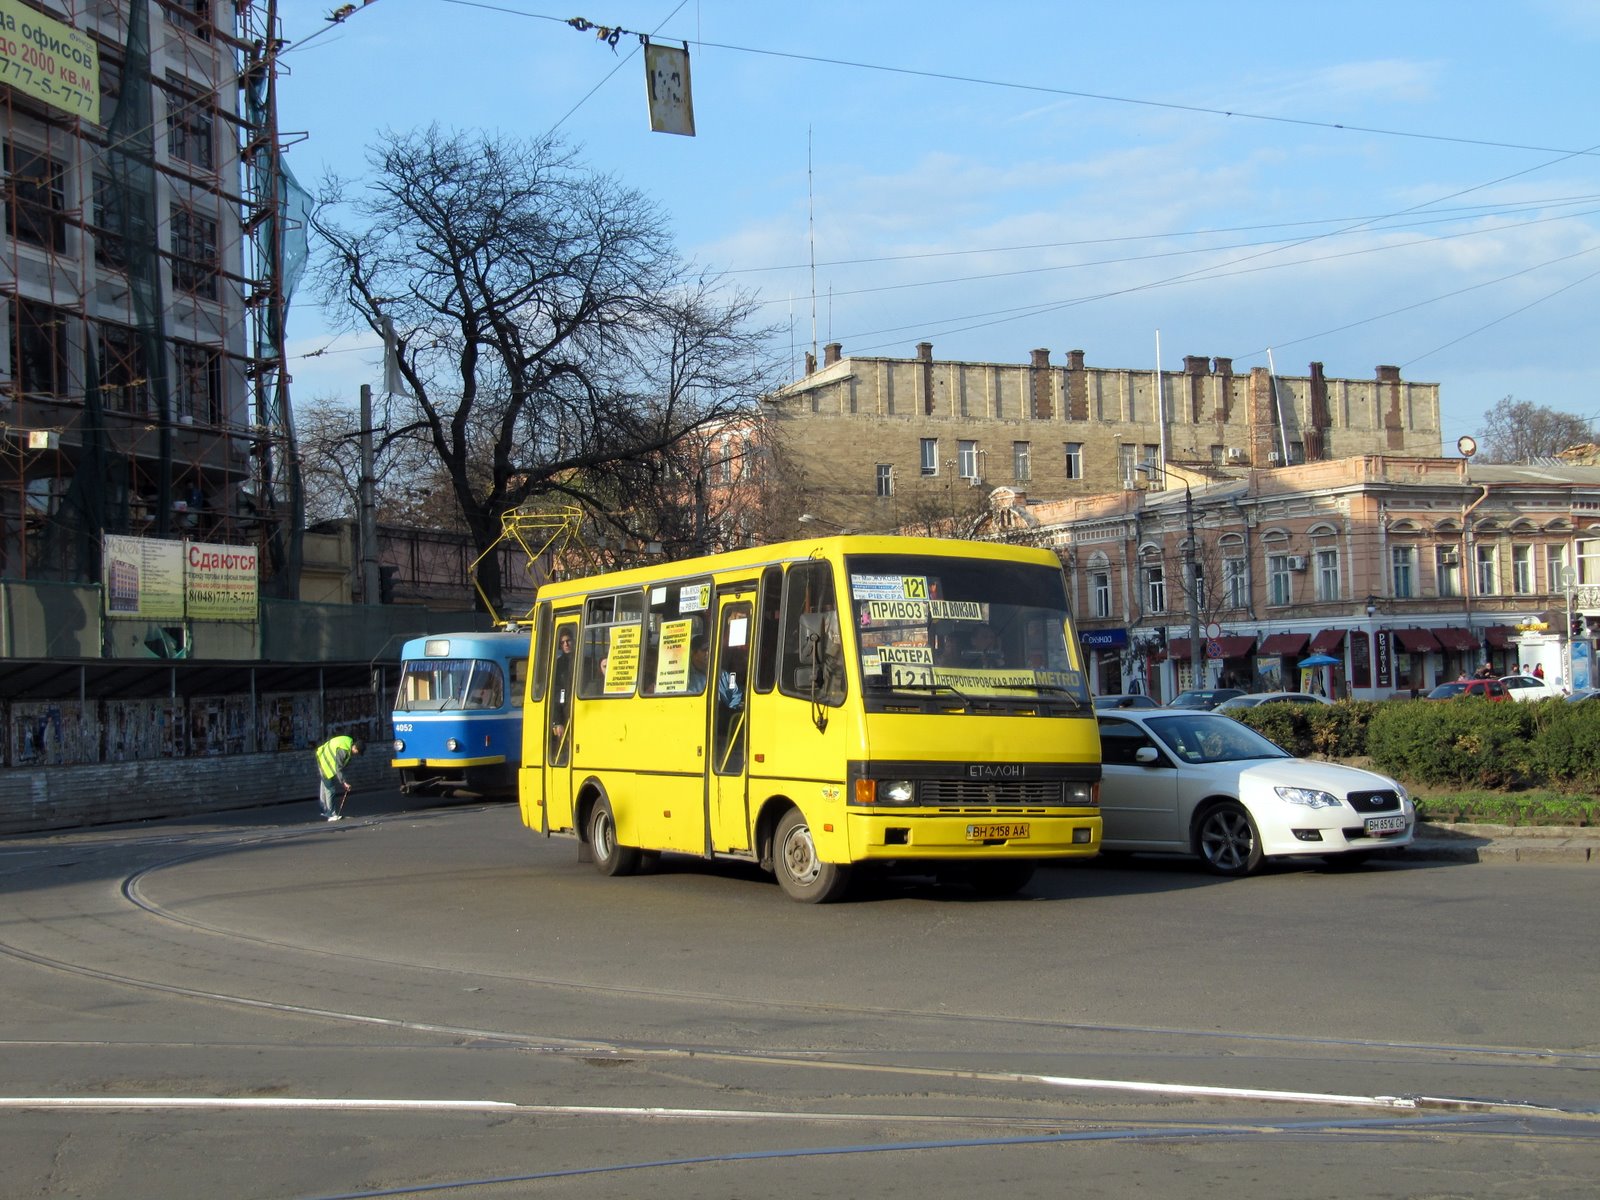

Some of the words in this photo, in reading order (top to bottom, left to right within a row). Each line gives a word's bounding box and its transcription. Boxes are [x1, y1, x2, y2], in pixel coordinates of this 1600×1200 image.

[21, 23, 92, 70] офисов
[21, 43, 55, 75] 2000
[189, 546, 256, 572] Сдаются
[904, 579, 926, 597] 121
[872, 602, 922, 618] ПРИВОЗ
[949, 602, 979, 618] ВОКЗАЛ
[879, 648, 931, 663] ПАСТЕРА
[1036, 671, 1080, 687] METRO
[989, 826, 1010, 837] 2158
